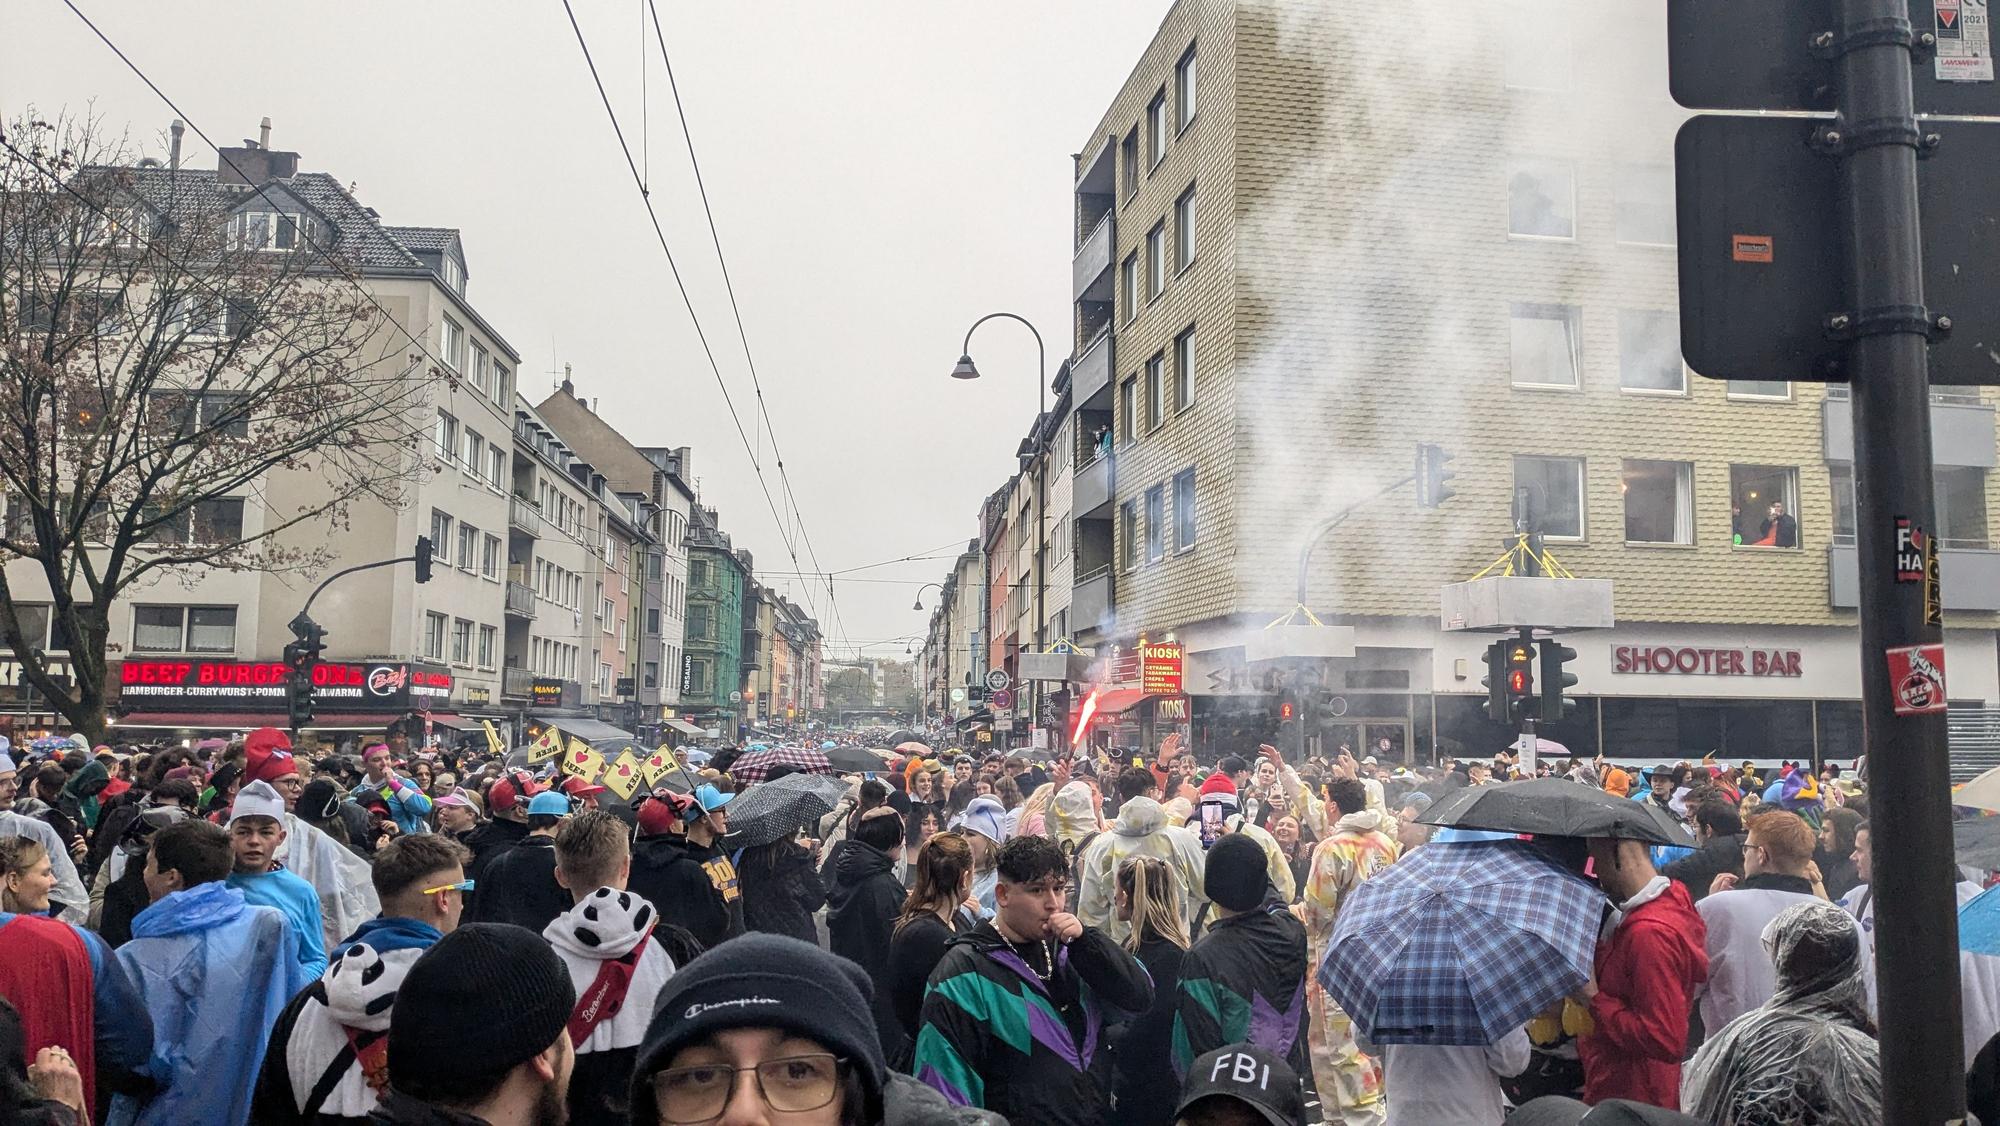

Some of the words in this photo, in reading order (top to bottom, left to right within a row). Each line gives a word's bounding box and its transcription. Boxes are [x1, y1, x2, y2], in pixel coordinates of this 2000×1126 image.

[1963, 15, 1986, 24] 2021
[1144, 647, 1181, 659] KIOSK
[1616, 647, 1746, 674] SHOOTER
[1752, 650, 1803, 676] BAR
[122, 662, 192, 685] BEEF
[199, 662, 294, 685] BURGE
[311, 664, 365, 687] ONE
[122, 686, 286, 697] HAMBURGER-CURRYWURST-POMM
[534, 685, 561, 694] MANGO
[1158, 699, 1186, 719] KIOSK
[685, 996, 781, 1020] Champion
[1210, 1052, 1270, 1090] FBI
